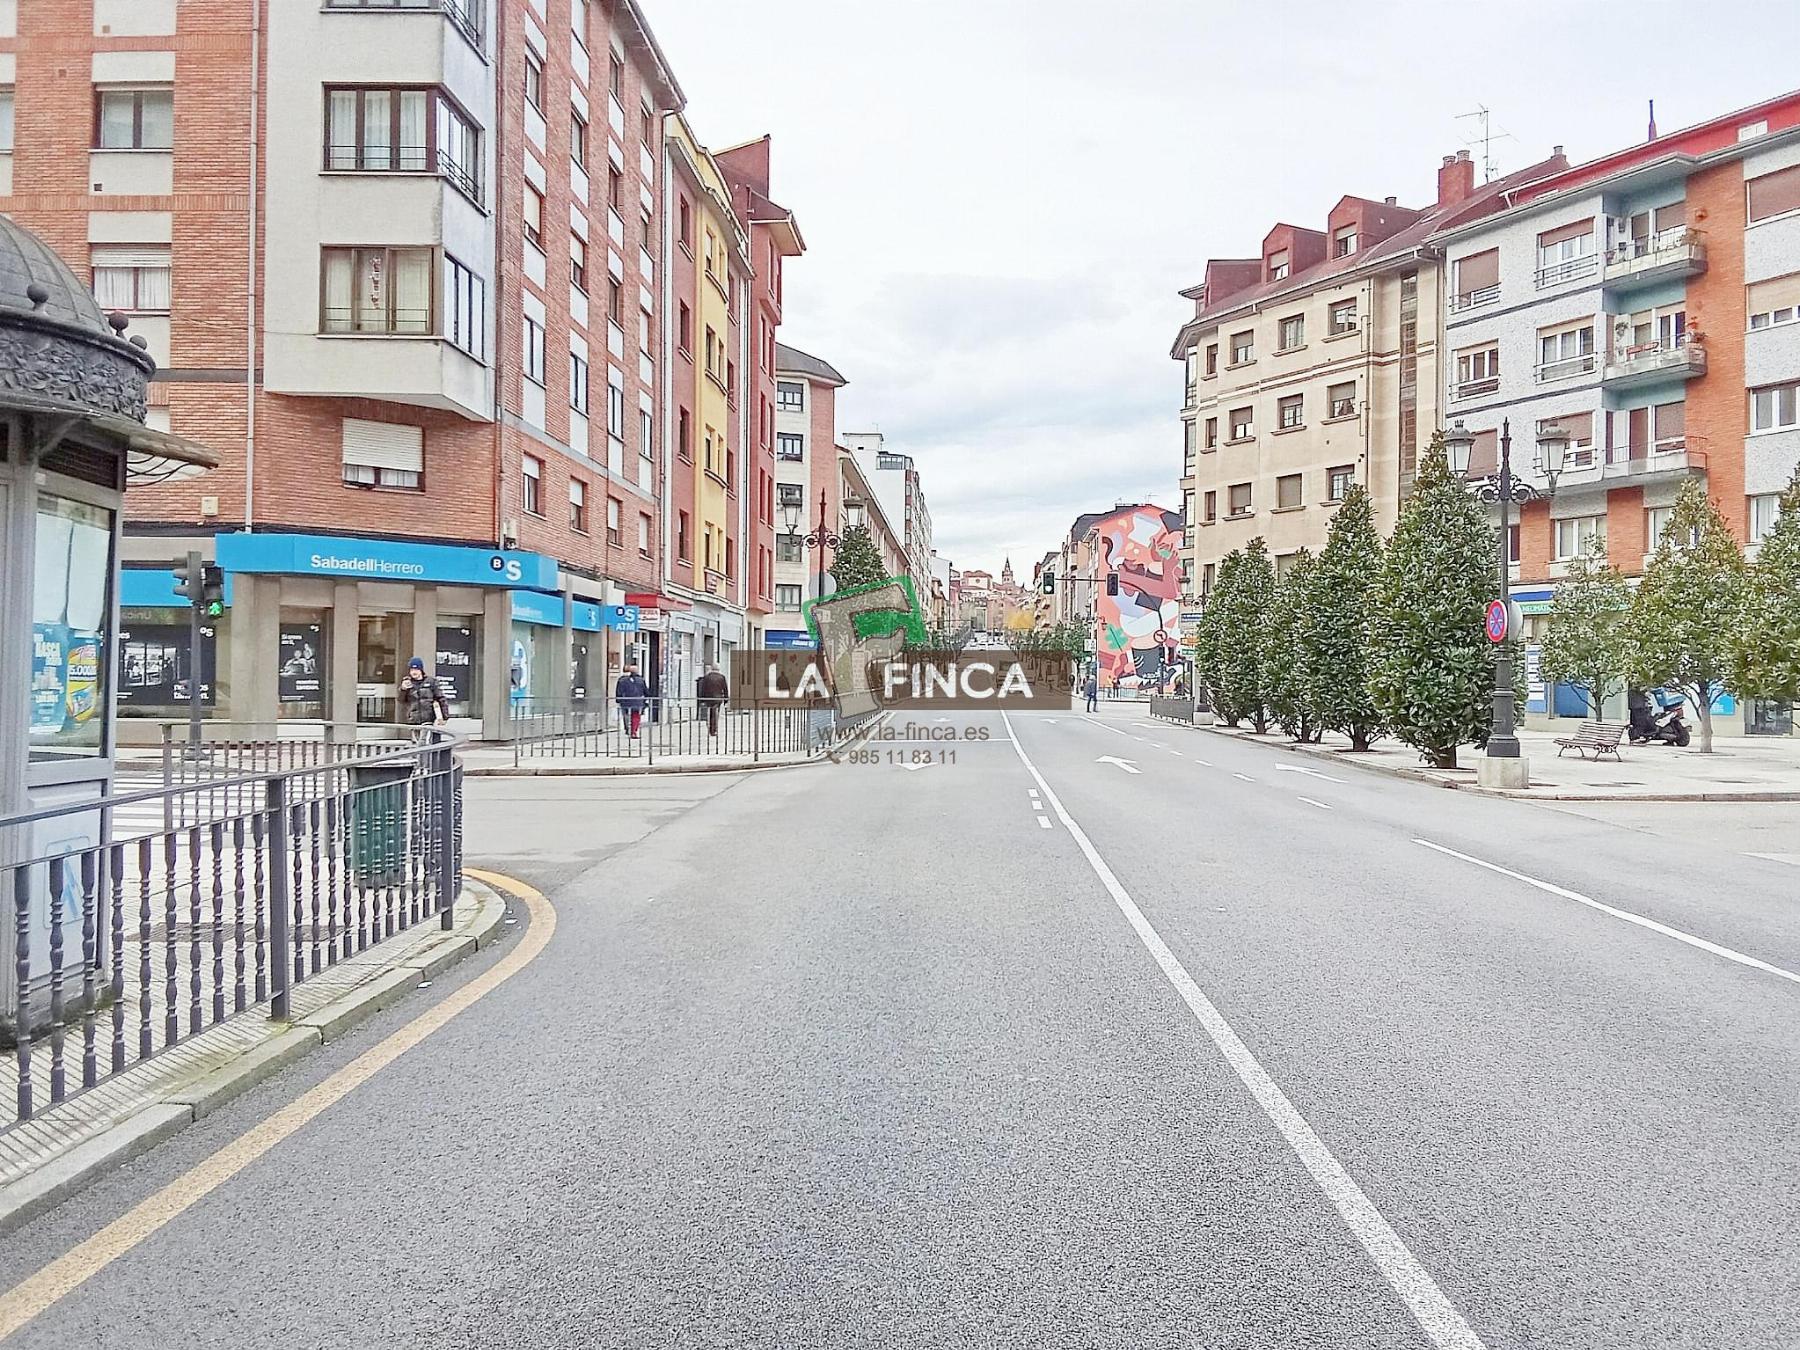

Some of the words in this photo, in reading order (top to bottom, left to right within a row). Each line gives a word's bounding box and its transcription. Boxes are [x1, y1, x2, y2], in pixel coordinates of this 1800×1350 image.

[311, 554, 424, 575] SabadellHerrero
[505, 559, 522, 581] S
[615, 622, 635, 631] ATM
